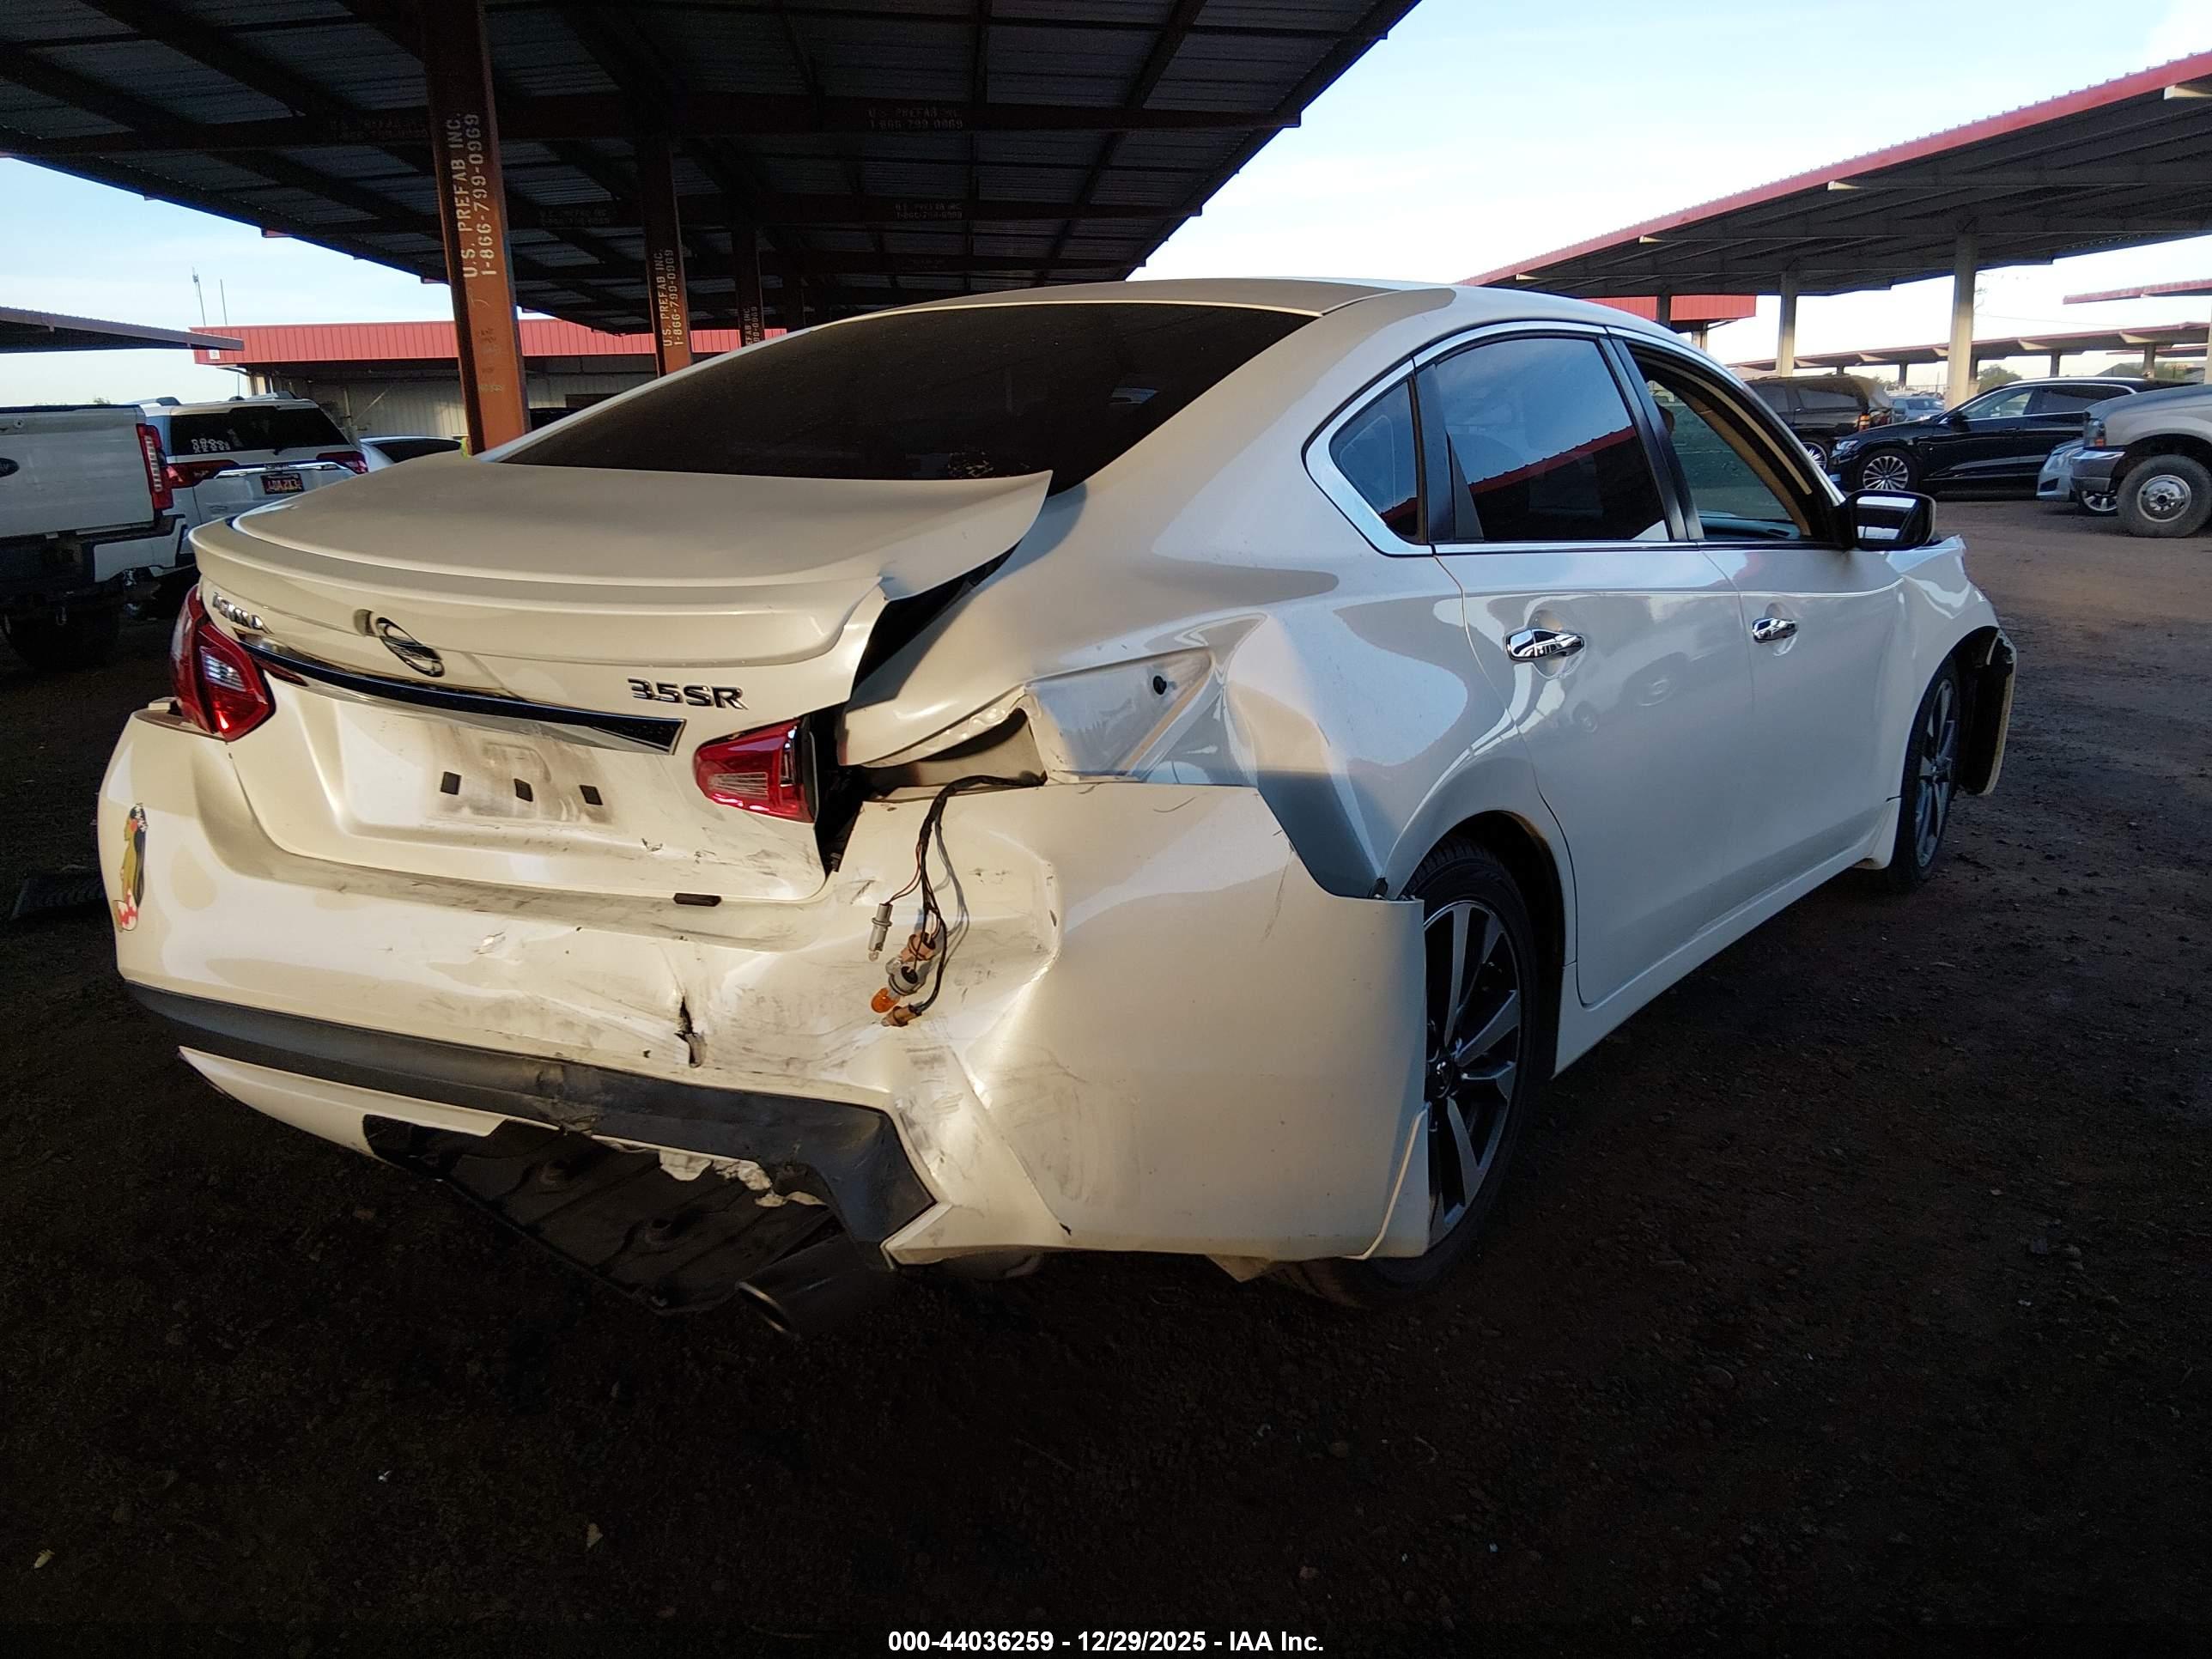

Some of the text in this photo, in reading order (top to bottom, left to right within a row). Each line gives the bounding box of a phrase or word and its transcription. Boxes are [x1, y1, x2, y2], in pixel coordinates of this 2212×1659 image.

[447, 113, 478, 277] U.S. PREFAB INC.
[465, 114, 496, 275] 1-866-799-0969
[656, 276, 670, 319] PREFAB
[662, 325, 672, 347] U.S.
[665, 249, 684, 345] 1-866-799-0969
